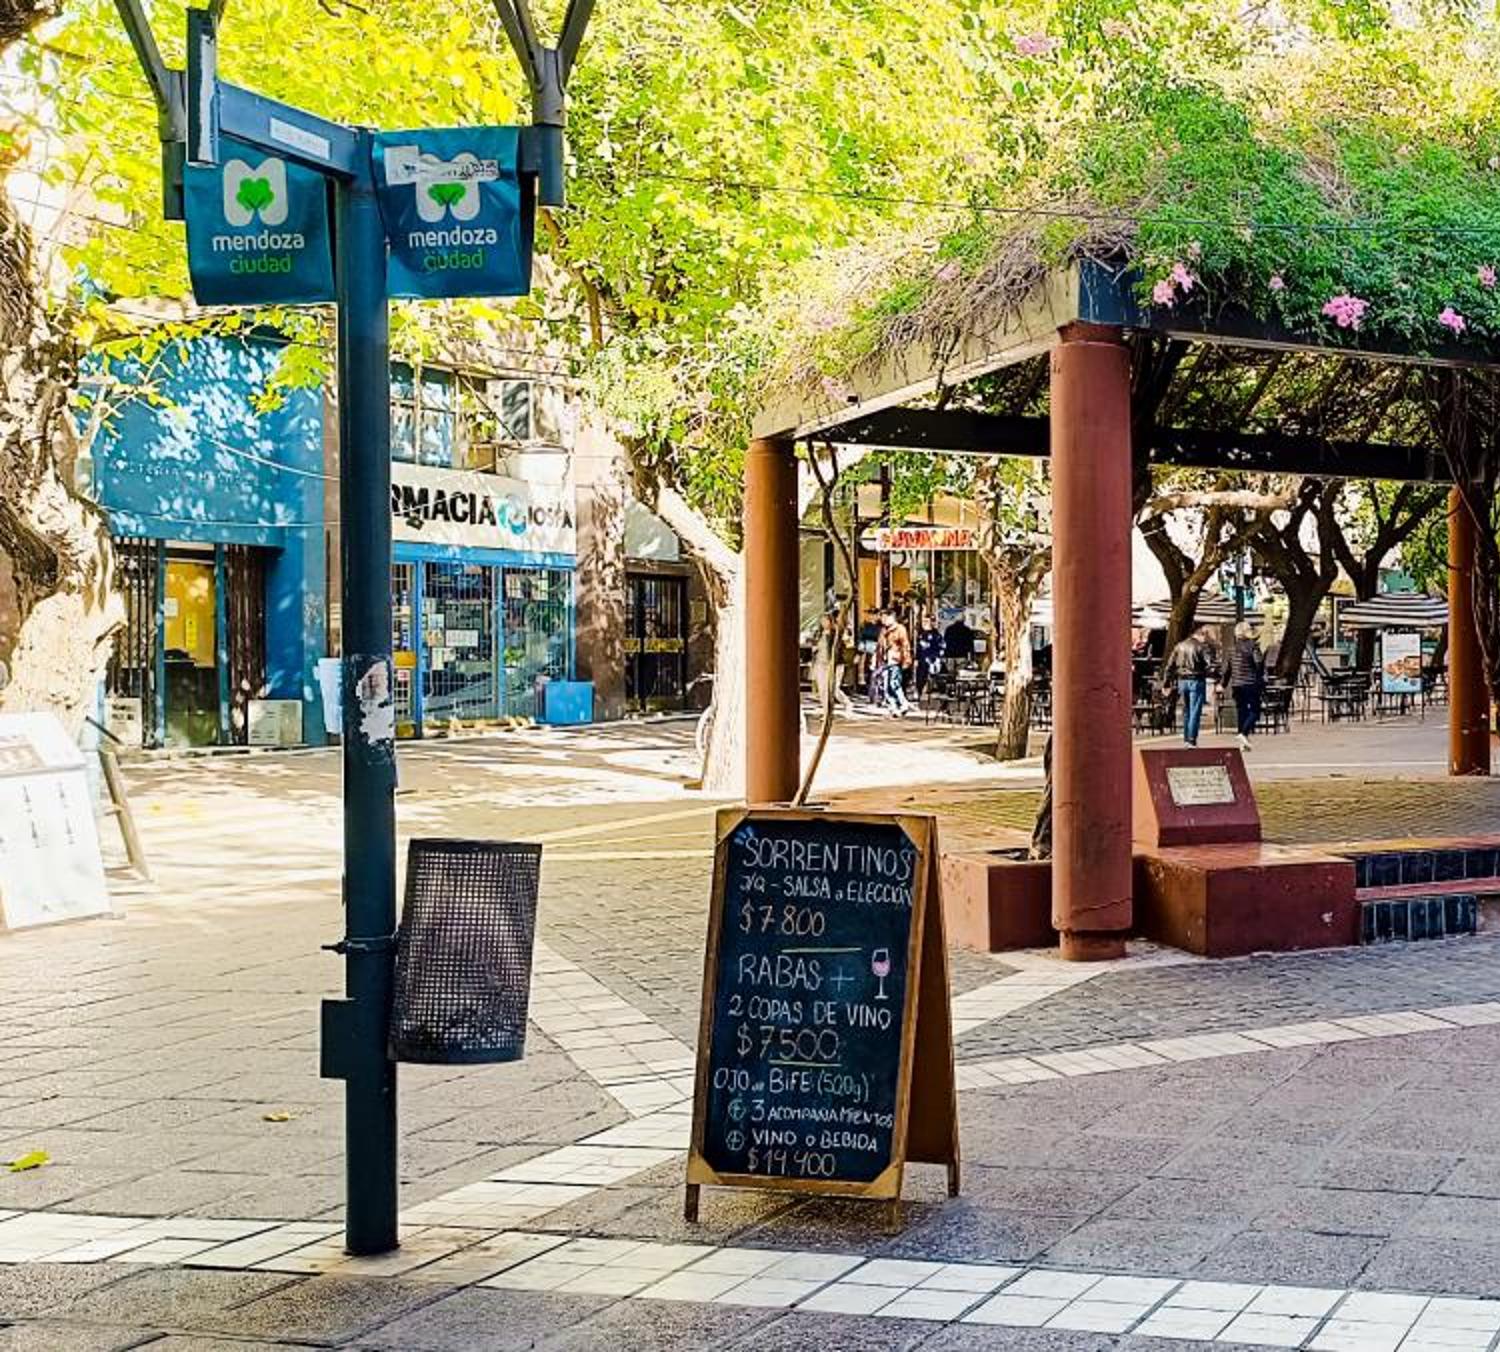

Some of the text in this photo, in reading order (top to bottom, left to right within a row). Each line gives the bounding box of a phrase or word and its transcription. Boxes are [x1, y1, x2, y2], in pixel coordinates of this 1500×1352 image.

[213, 231, 304, 251] mendoza
[409, 226, 497, 249] mendoza
[230, 254, 291, 273] ciudad
[424, 249, 485, 272] ciudad
[391, 483, 497, 526] RMACIA
[742, 838, 913, 881] SORRENTINOS
[783, 875, 831, 899] SALSA
[738, 953, 823, 991] RABAS
[728, 994, 892, 1031] 2 COPAS DE VINO
[714, 1068, 749, 1092] OJO
[818, 1070, 869, 1103] (500g)
[751, 1099, 765, 1121] 3
[752, 1129, 797, 1146] VINO
[820, 1130, 878, 1152] BEBIDA
